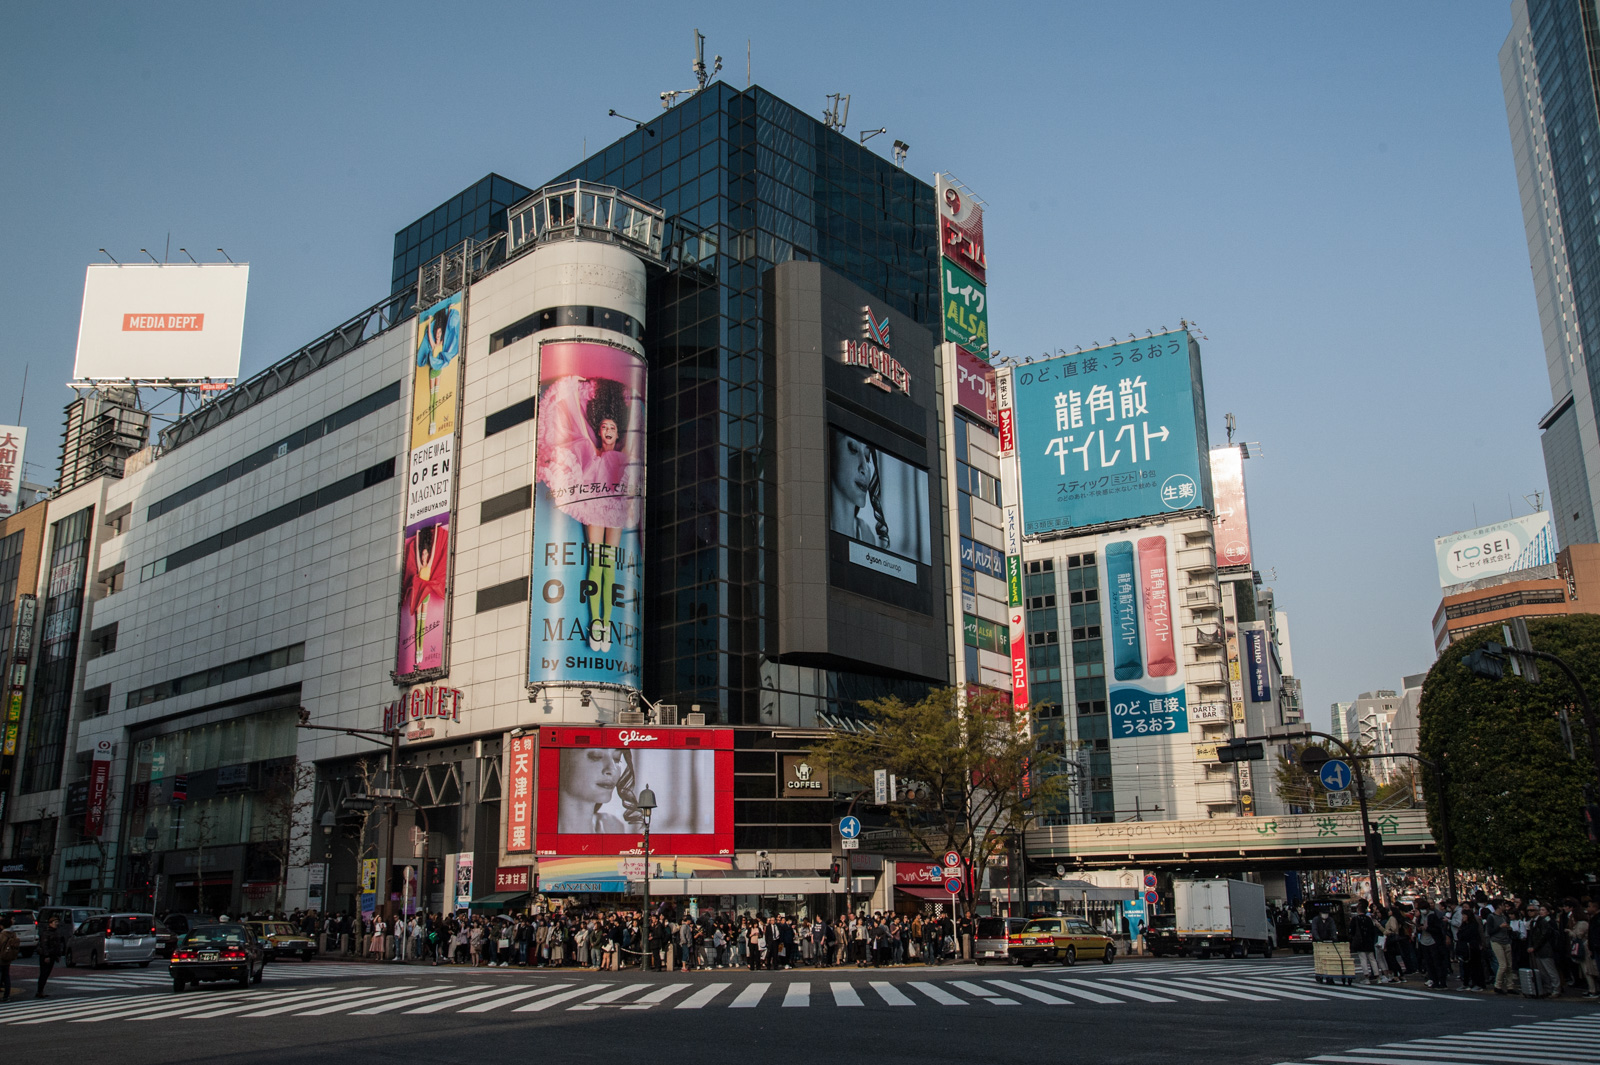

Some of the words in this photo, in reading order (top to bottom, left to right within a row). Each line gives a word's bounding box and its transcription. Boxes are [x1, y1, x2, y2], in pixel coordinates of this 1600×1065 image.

[947, 222, 987, 269] アコム
[946, 269, 985, 313] レイク
[129, 316, 165, 328] MEDIA
[167, 316, 199, 328] DEPT.
[946, 300, 988, 343] ALSA
[841, 338, 911, 396] MAGNET
[1019, 339, 1181, 386] のど、直接、うるおう
[958, 364, 996, 401] アイフル
[1054, 375, 1149, 431] 龍角散
[1002, 419, 1012, 450] アイフル
[413, 440, 451, 466] RENEWAL
[1044, 421, 1170, 476] ダイレクト
[411, 459, 450, 485] OPEN
[1056, 475, 1109, 494] スティック
[1113, 473, 1135, 484] ミント
[410, 478, 449, 505] MAGNET
[1163, 482, 1194, 501] 生薬
[1007, 508, 1017, 554] レオパレス21
[544, 541, 641, 579] RENEWAL
[866, 553, 882, 565] dyson
[961, 545, 1003, 574] レオパレス21
[1453, 538, 1510, 562] TOSEI
[1009, 557, 1018, 577] レイク
[542, 578, 641, 615] OPEN
[1011, 576, 1019, 602] ALSA
[542, 616, 640, 650] MAGNET
[978, 626, 993, 638] ALSA
[1253, 634, 1263, 664] MIZUHO
[541, 656, 559, 670] by
[1014, 658, 1025, 688] アコム
[383, 686, 463, 731] MAGNET
[1114, 697, 1186, 716] のど、直接、
[1192, 705, 1217, 713] DARTS
[618, 730, 658, 746] Glico
[1122, 716, 1176, 735] うるおう
[513, 739, 532, 752] 名物
[787, 780, 821, 789] COFFEE
[512, 753, 529, 848] 天津甘栗
[1257, 821, 1277, 834] JR
[497, 873, 528, 886] 天津甘栗
[554, 883, 601, 891] SANZENRI
